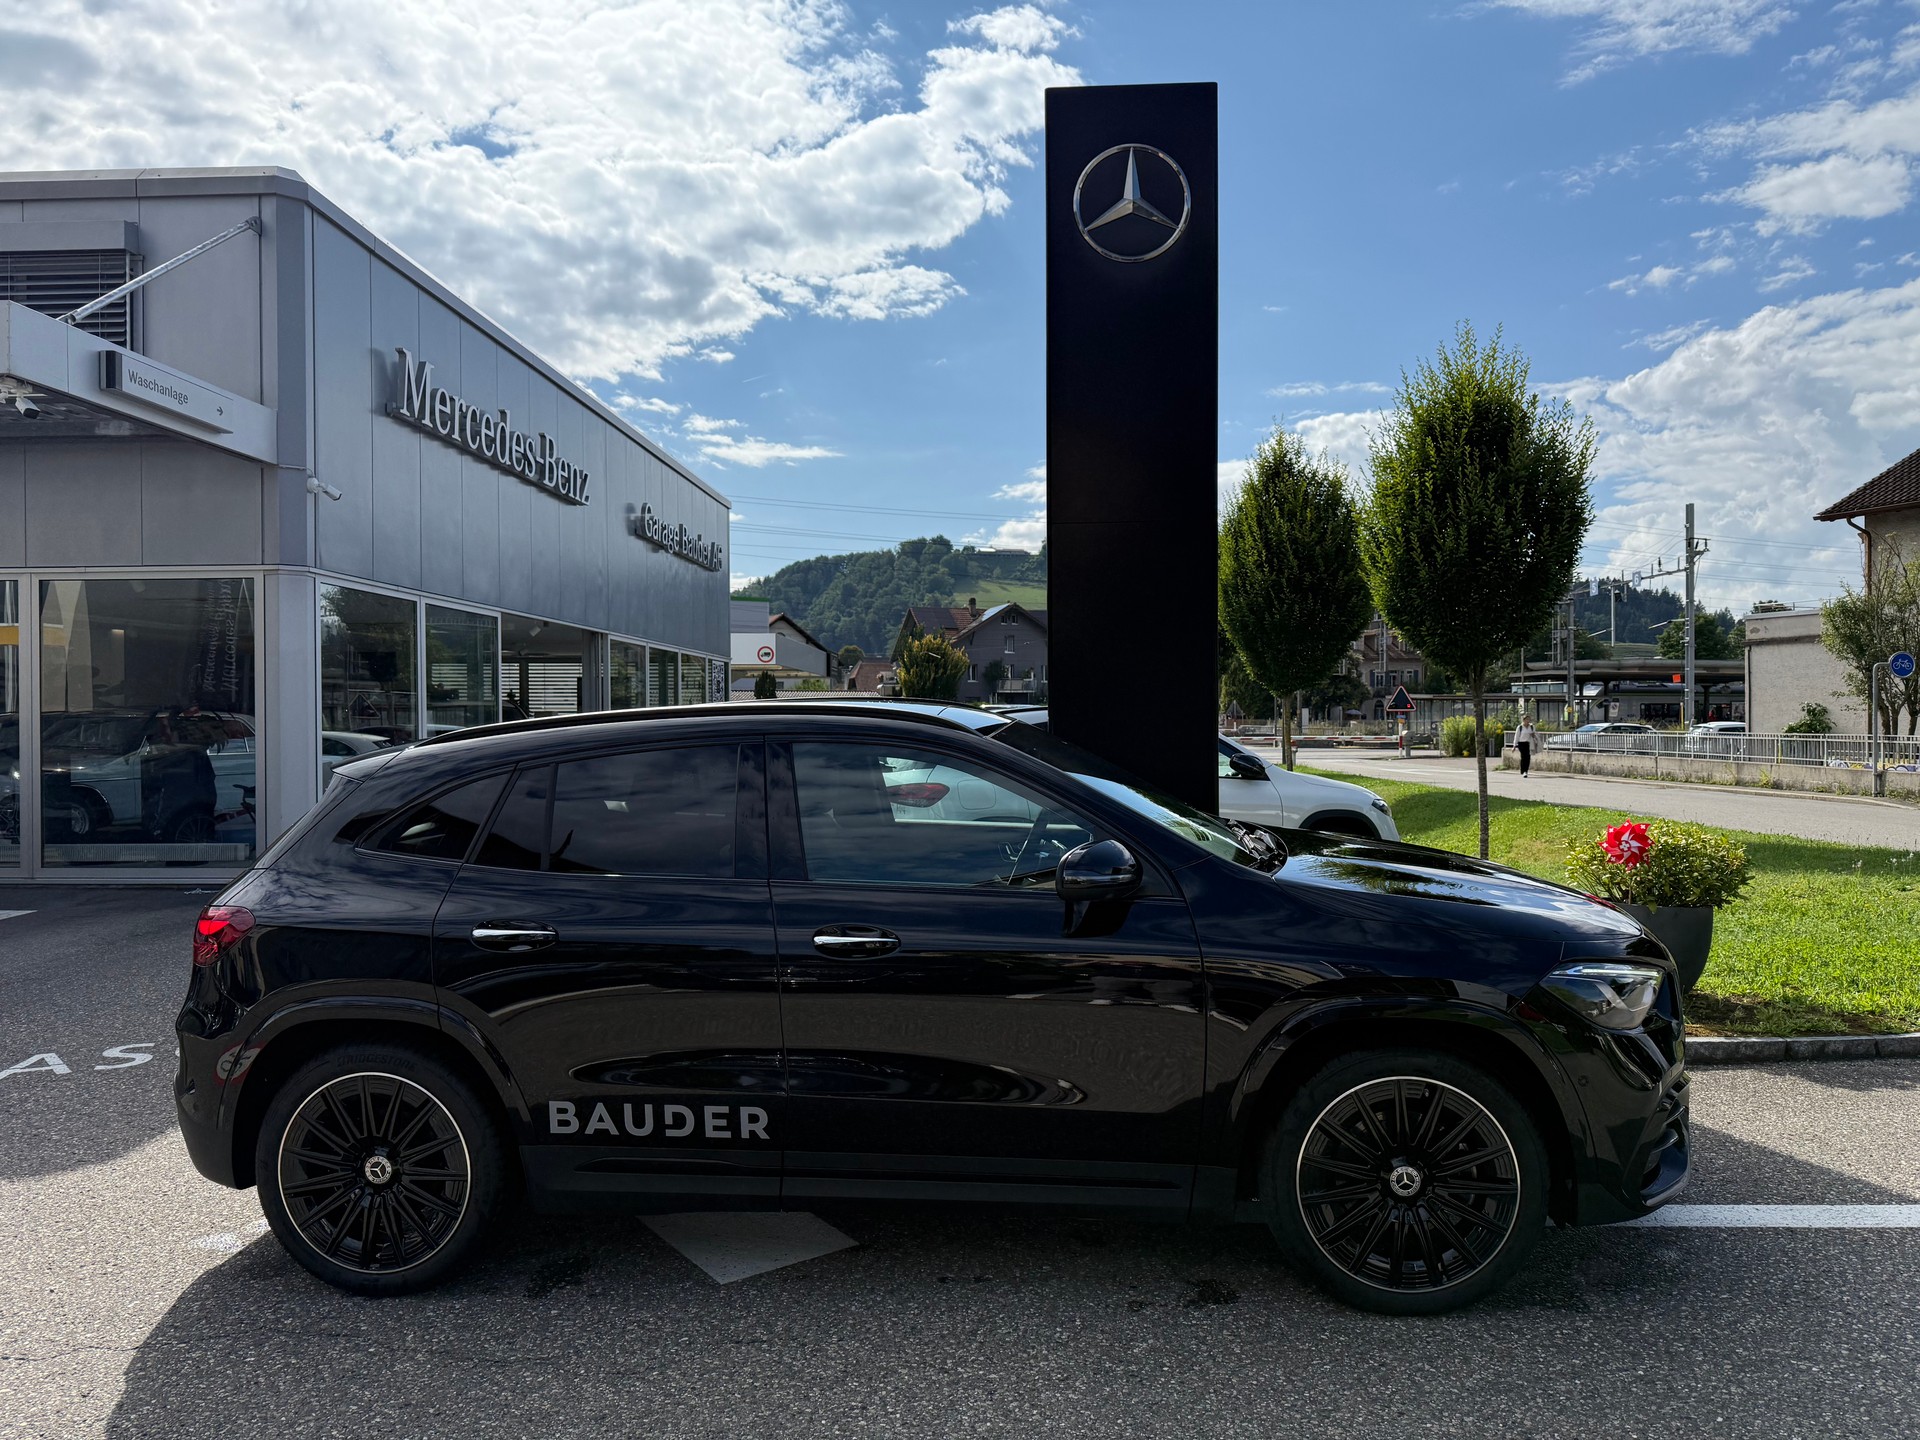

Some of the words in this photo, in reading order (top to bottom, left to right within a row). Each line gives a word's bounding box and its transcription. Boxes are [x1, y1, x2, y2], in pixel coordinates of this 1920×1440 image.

[127, 368, 189, 405] Waschanlage
[397, 347, 591, 506] Mercedes-Benz
[643, 502, 680, 554] Garage
[682, 524, 711, 567] Bauder
[336, 1053, 417, 1071] BRIDGESTONE
[549, 1100, 770, 1140] BAUDER
